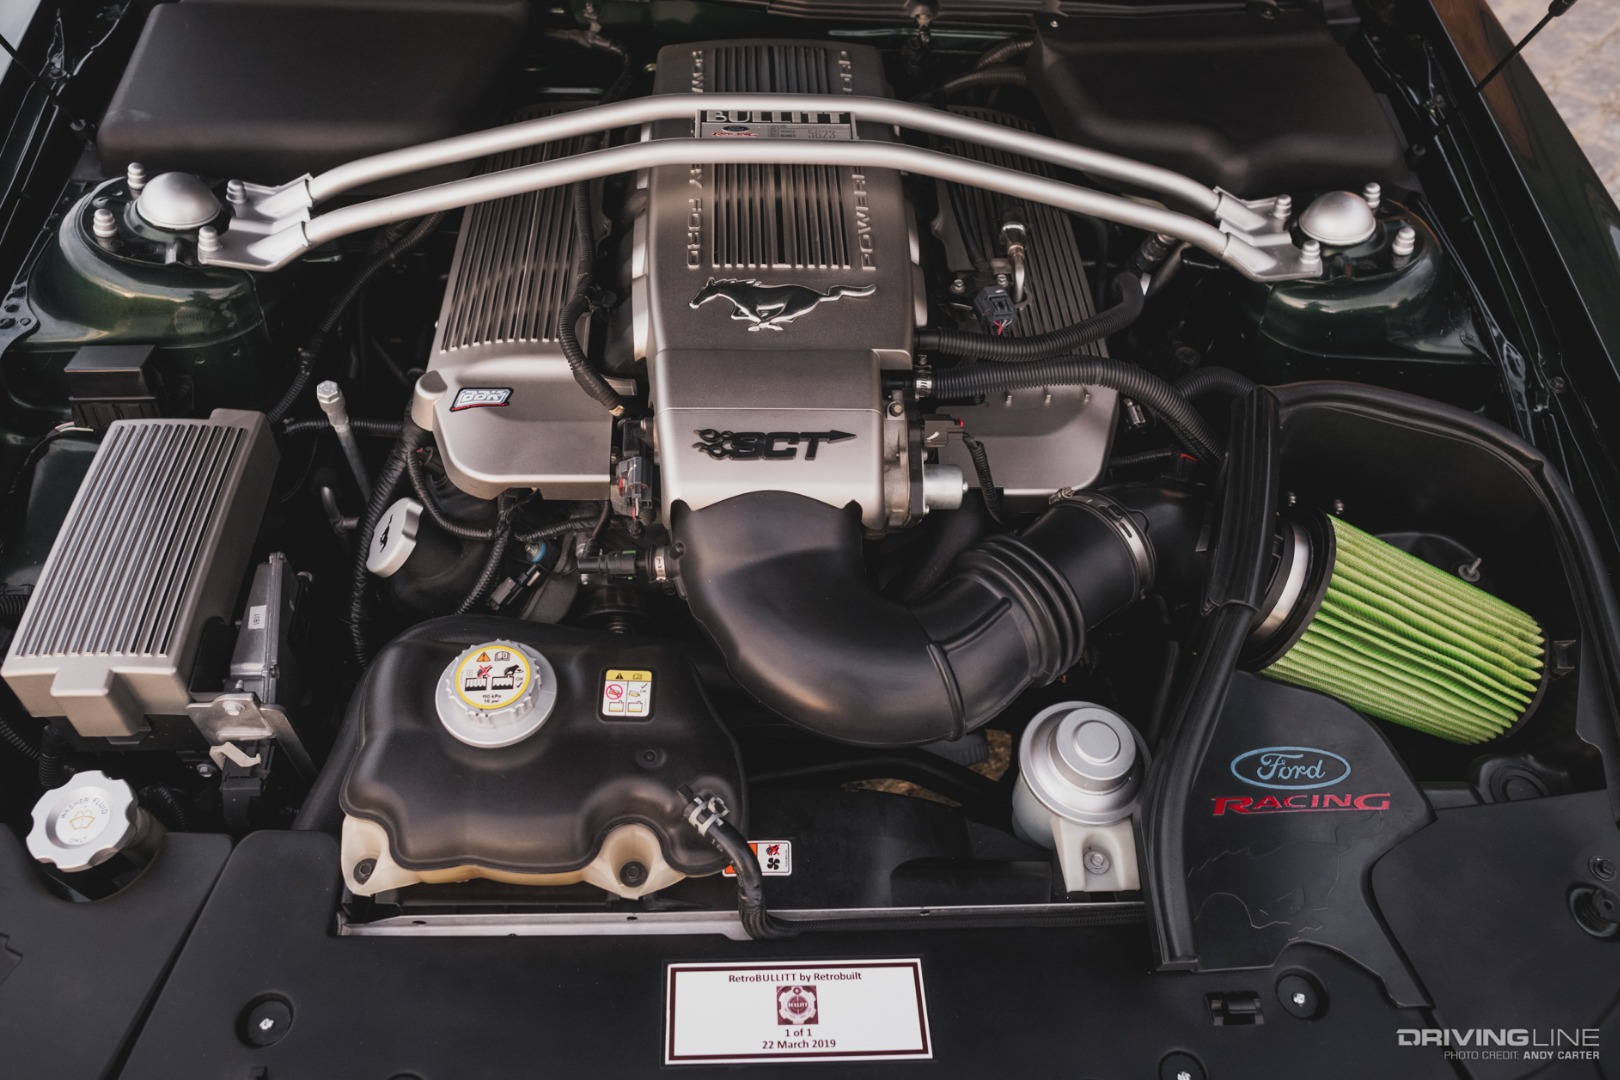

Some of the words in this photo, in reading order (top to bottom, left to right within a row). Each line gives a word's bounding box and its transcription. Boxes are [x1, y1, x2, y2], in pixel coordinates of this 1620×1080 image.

[706, 110, 846, 124] BULLITT
[687, 198, 704, 270] FORD
[729, 430, 857, 461] SCT
[1256, 752, 1327, 781] Ford
[61, 797, 89, 819] WASHER
[93, 797, 109, 815] FLUID
[1211, 793, 1391, 816] RACING
[728, 973, 797, 983] RetroBULLITT
[799, 972, 811, 983] by
[813, 971, 862, 981] Retrobuilt
[785, 1028, 791, 1037] 1
[793, 1028, 804, 1037] of
[806, 1028, 812, 1037] 1
[762, 1041, 774, 1049] 22
[777, 1039, 810, 1049] March
[812, 1039, 837, 1048] 2019
